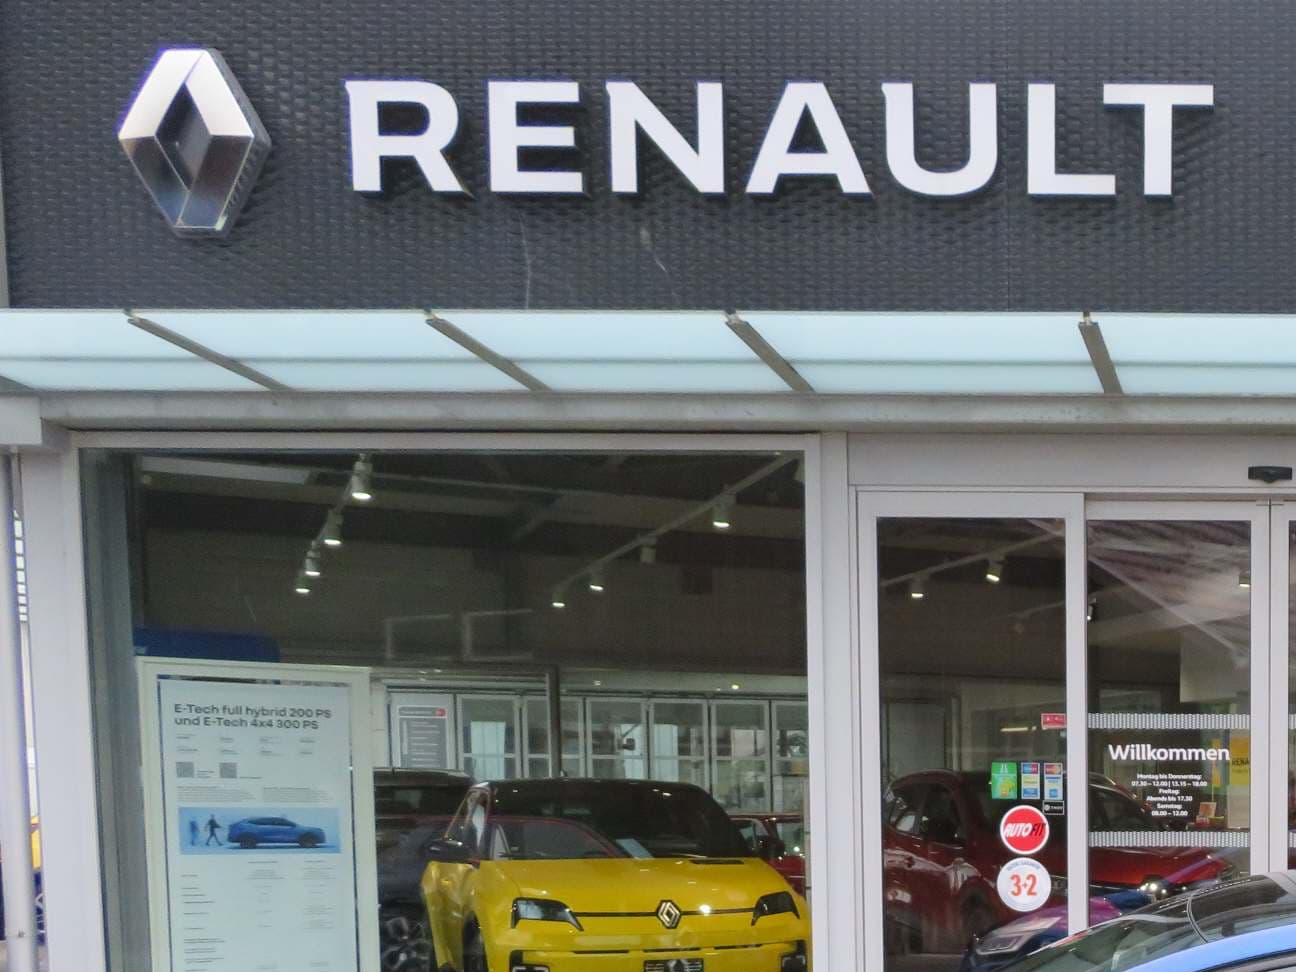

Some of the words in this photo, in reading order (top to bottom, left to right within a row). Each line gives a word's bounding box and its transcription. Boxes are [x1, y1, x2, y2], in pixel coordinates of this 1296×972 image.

[345, 79, 1215, 197] RENAULT
[174, 703, 219, 715] E-Tech
[222, 705, 242, 716] full
[245, 707, 287, 720] hybrid
[290, 708, 313, 718] 200
[316, 709, 332, 719] PS
[174, 717, 200, 726] und
[203, 717, 248, 728] E-Tech
[250, 719, 274, 728] 4x4
[277, 719, 300, 729] 300
[303, 720, 319, 730] PS
[1108, 744, 1230, 761] Willkommen
